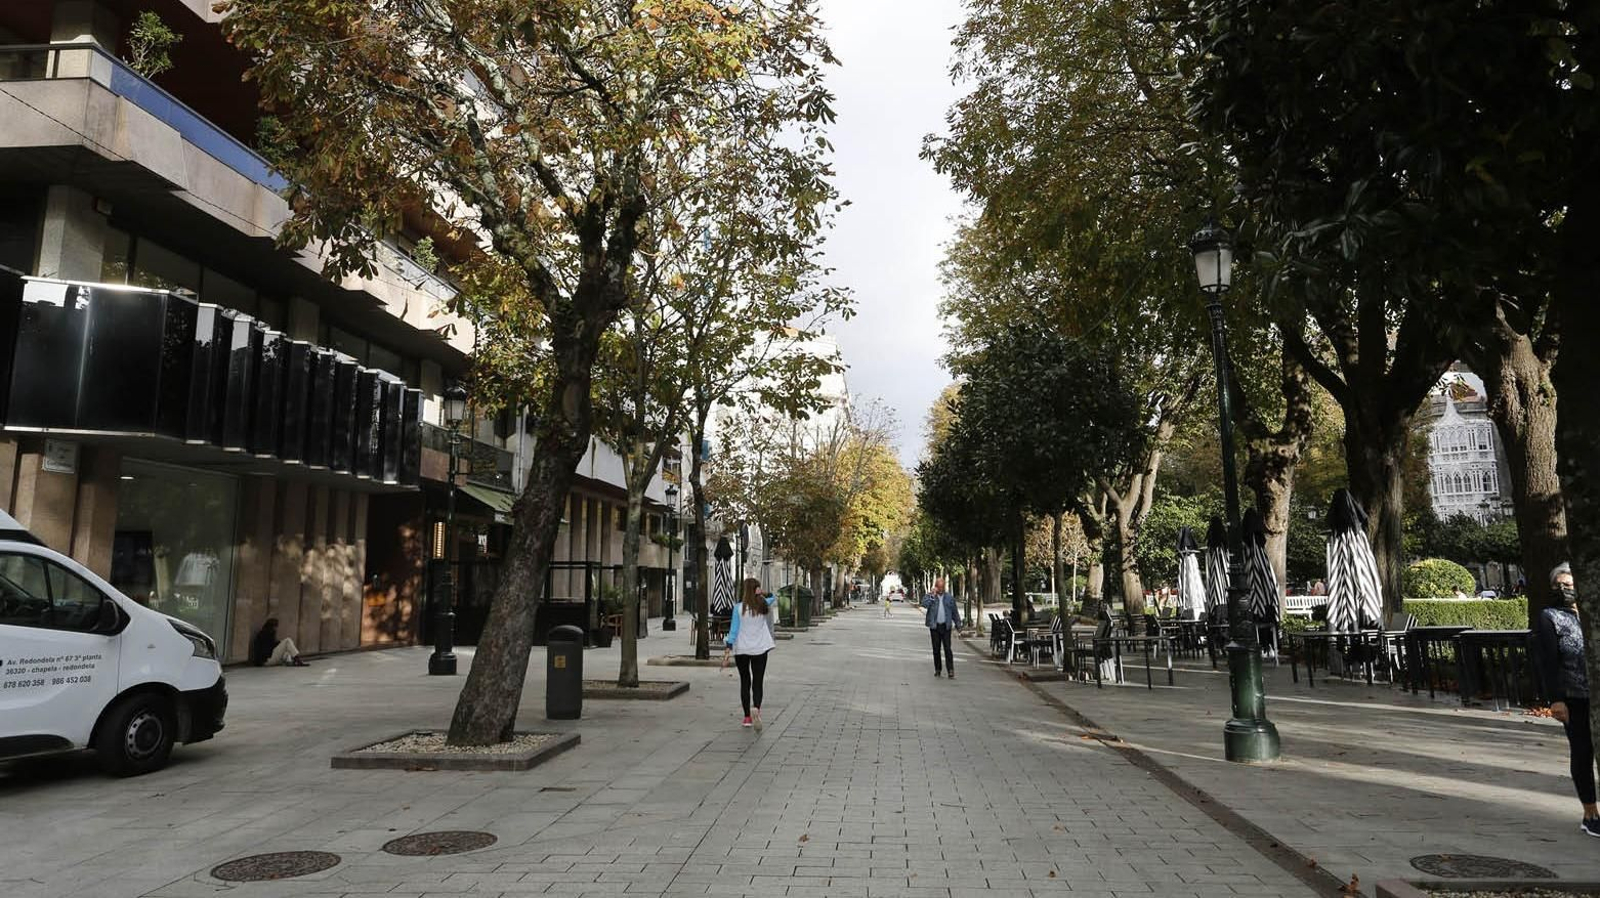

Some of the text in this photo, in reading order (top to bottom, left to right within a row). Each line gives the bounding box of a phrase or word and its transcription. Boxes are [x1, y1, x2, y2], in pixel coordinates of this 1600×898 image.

[19, 657, 55, 665] Redondela
[82, 654, 102, 662] planta
[32, 666, 57, 674] chapela
[63, 663, 95, 671] redondela
